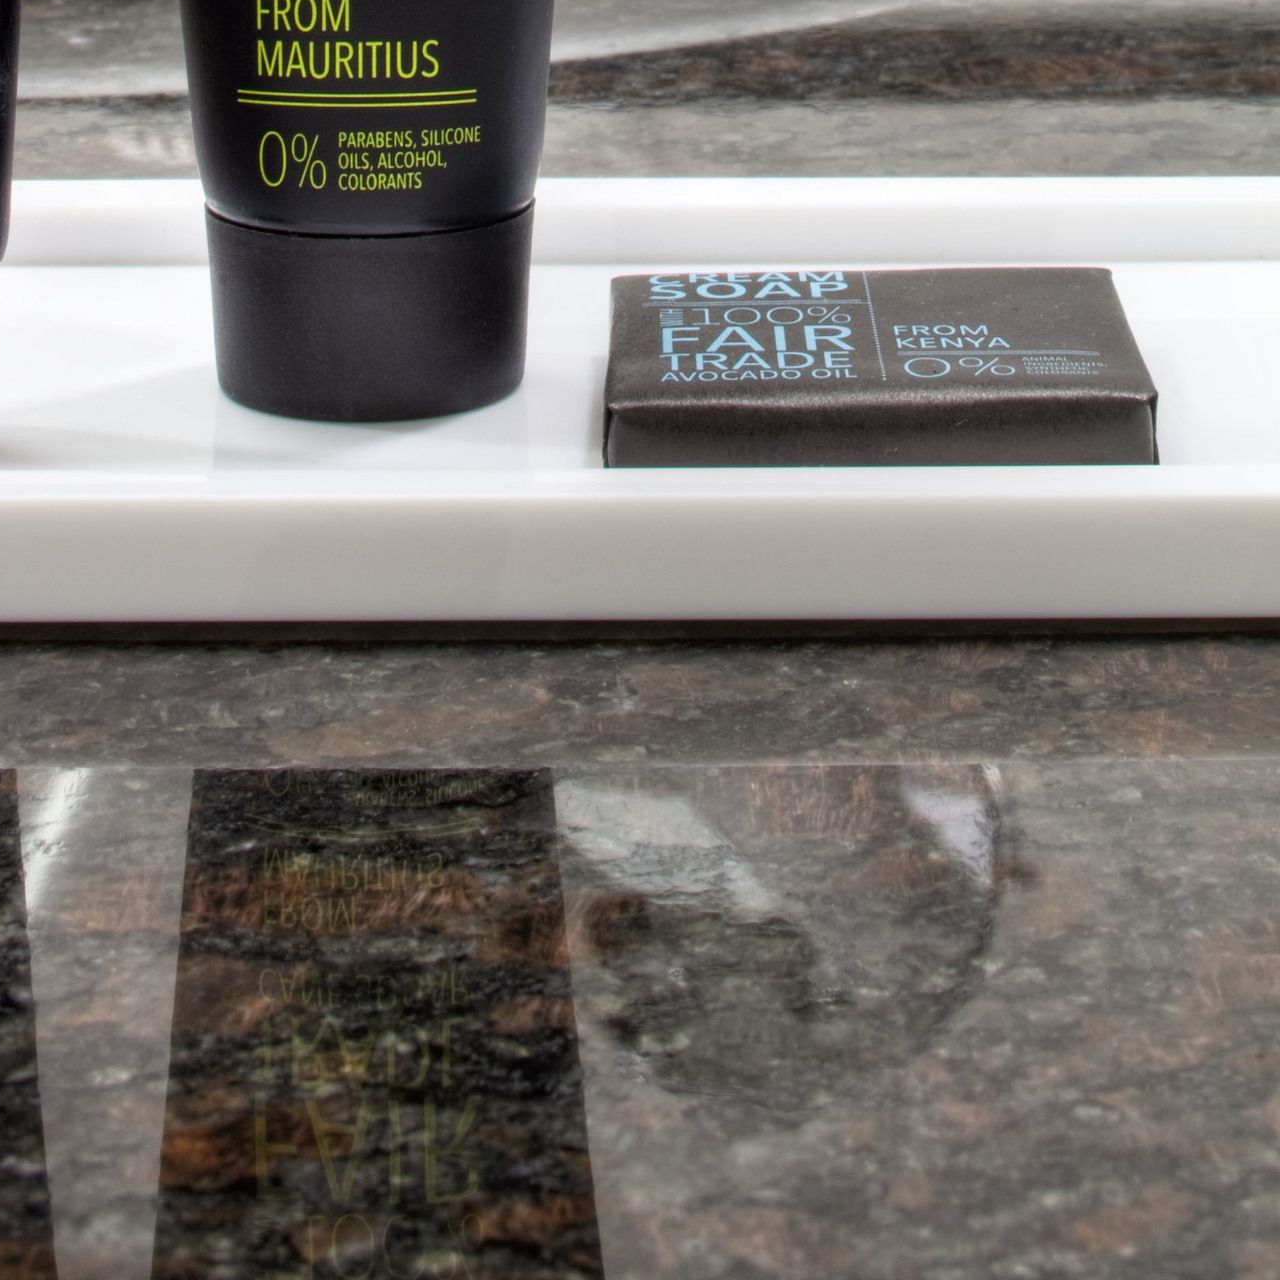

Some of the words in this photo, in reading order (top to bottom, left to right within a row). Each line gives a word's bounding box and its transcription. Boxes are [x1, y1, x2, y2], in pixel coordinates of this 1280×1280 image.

[258, 40, 439, 79] MAURITIUS
[260, 131, 326, 189] 0%
[339, 131, 416, 148] PARABENS,
[421, 126, 480, 146] SILICONE
[339, 153, 373, 171] OILS,
[378, 150, 447, 168] ALCOHOL,
[339, 172, 422, 190] COLORANTS
[649, 272, 844, 284] CREAM
[649, 282, 848, 300] SOAP
[694, 307, 851, 324] 100%
[663, 325, 854, 353] FAIR
[893, 324, 989, 336] FROM
[896, 336, 1010, 349] KENYA
[660, 351, 852, 371] TRADE
[904, 357, 1015, 378] 0%
[662, 370, 801, 381] AVOCADO
[812, 368, 857, 378] OIL
